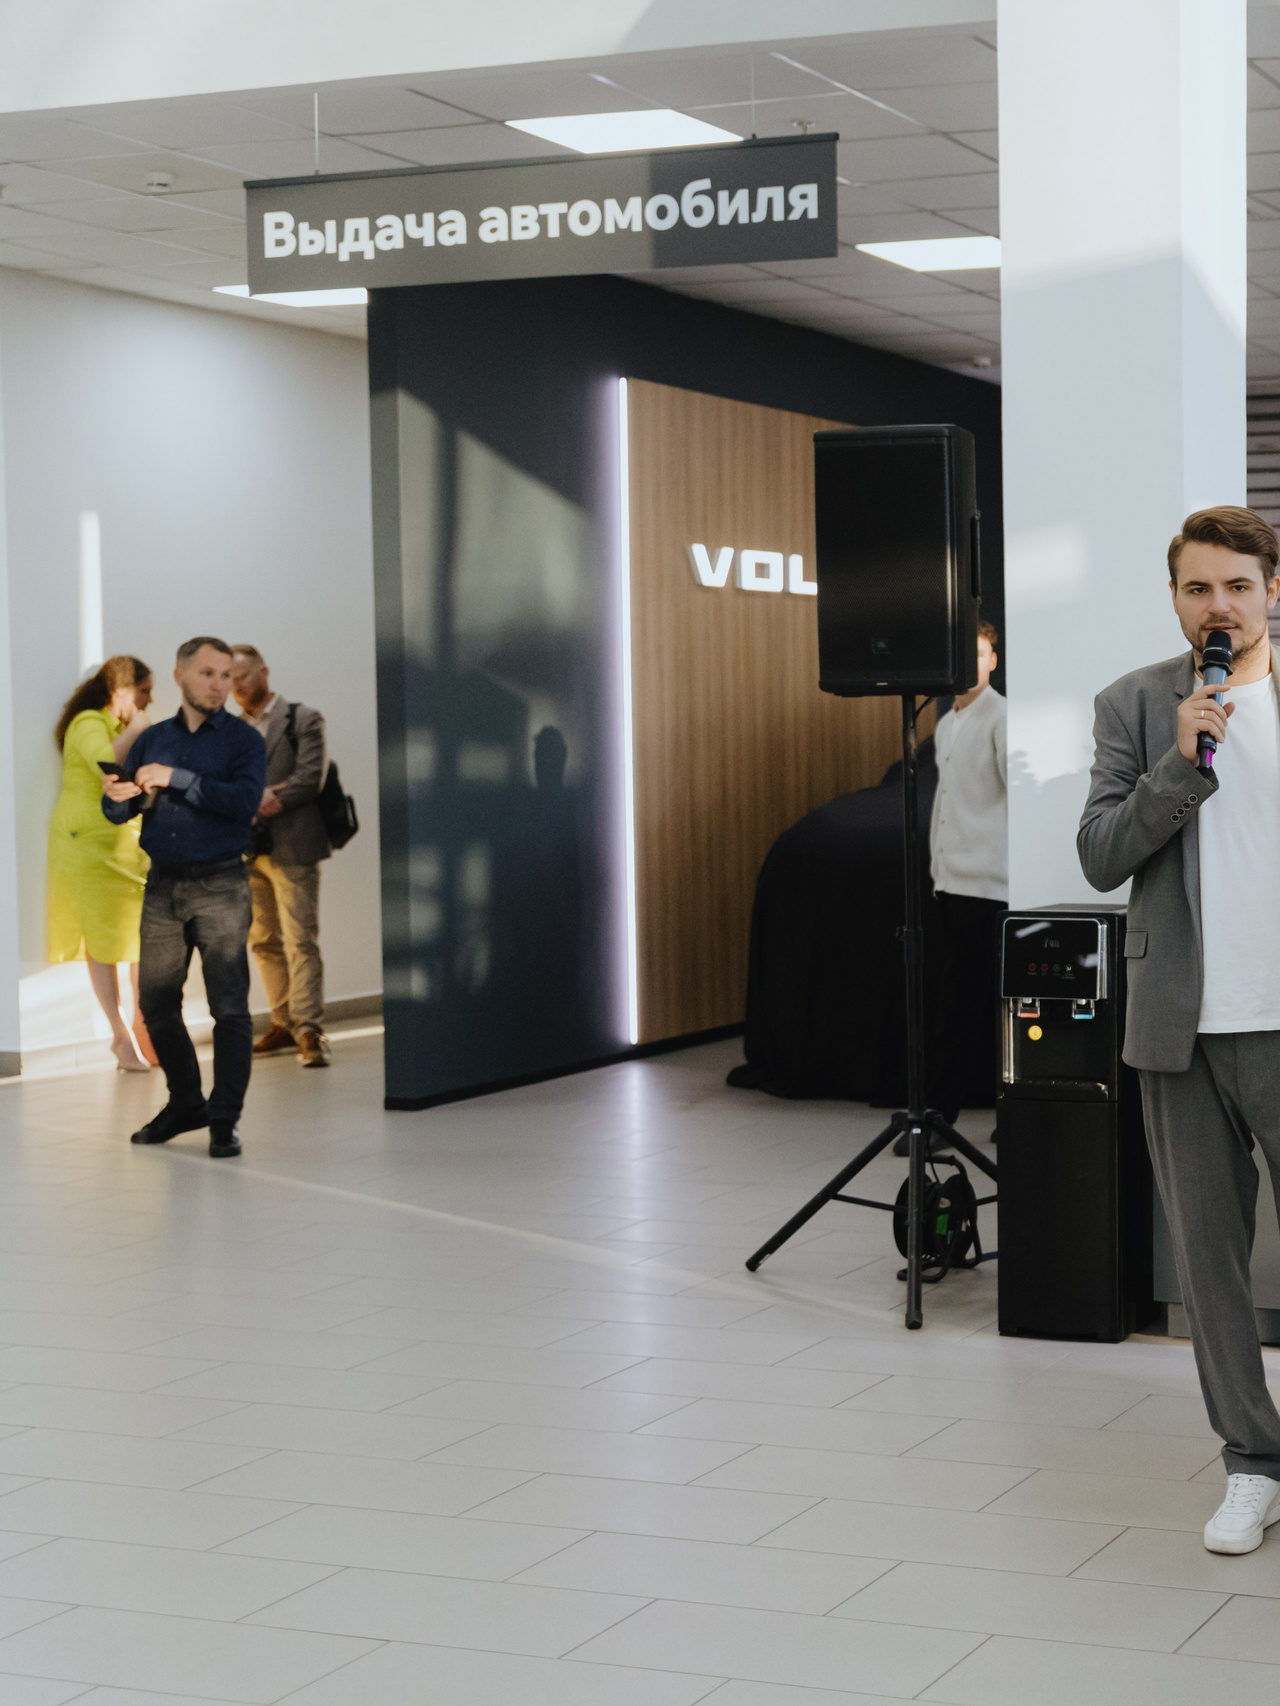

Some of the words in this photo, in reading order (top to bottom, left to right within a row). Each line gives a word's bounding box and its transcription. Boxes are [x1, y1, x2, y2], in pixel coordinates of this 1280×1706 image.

[263, 208, 469, 262] Выдача
[478, 178, 819, 244] автомобиля
[689, 543, 819, 596] VOL
